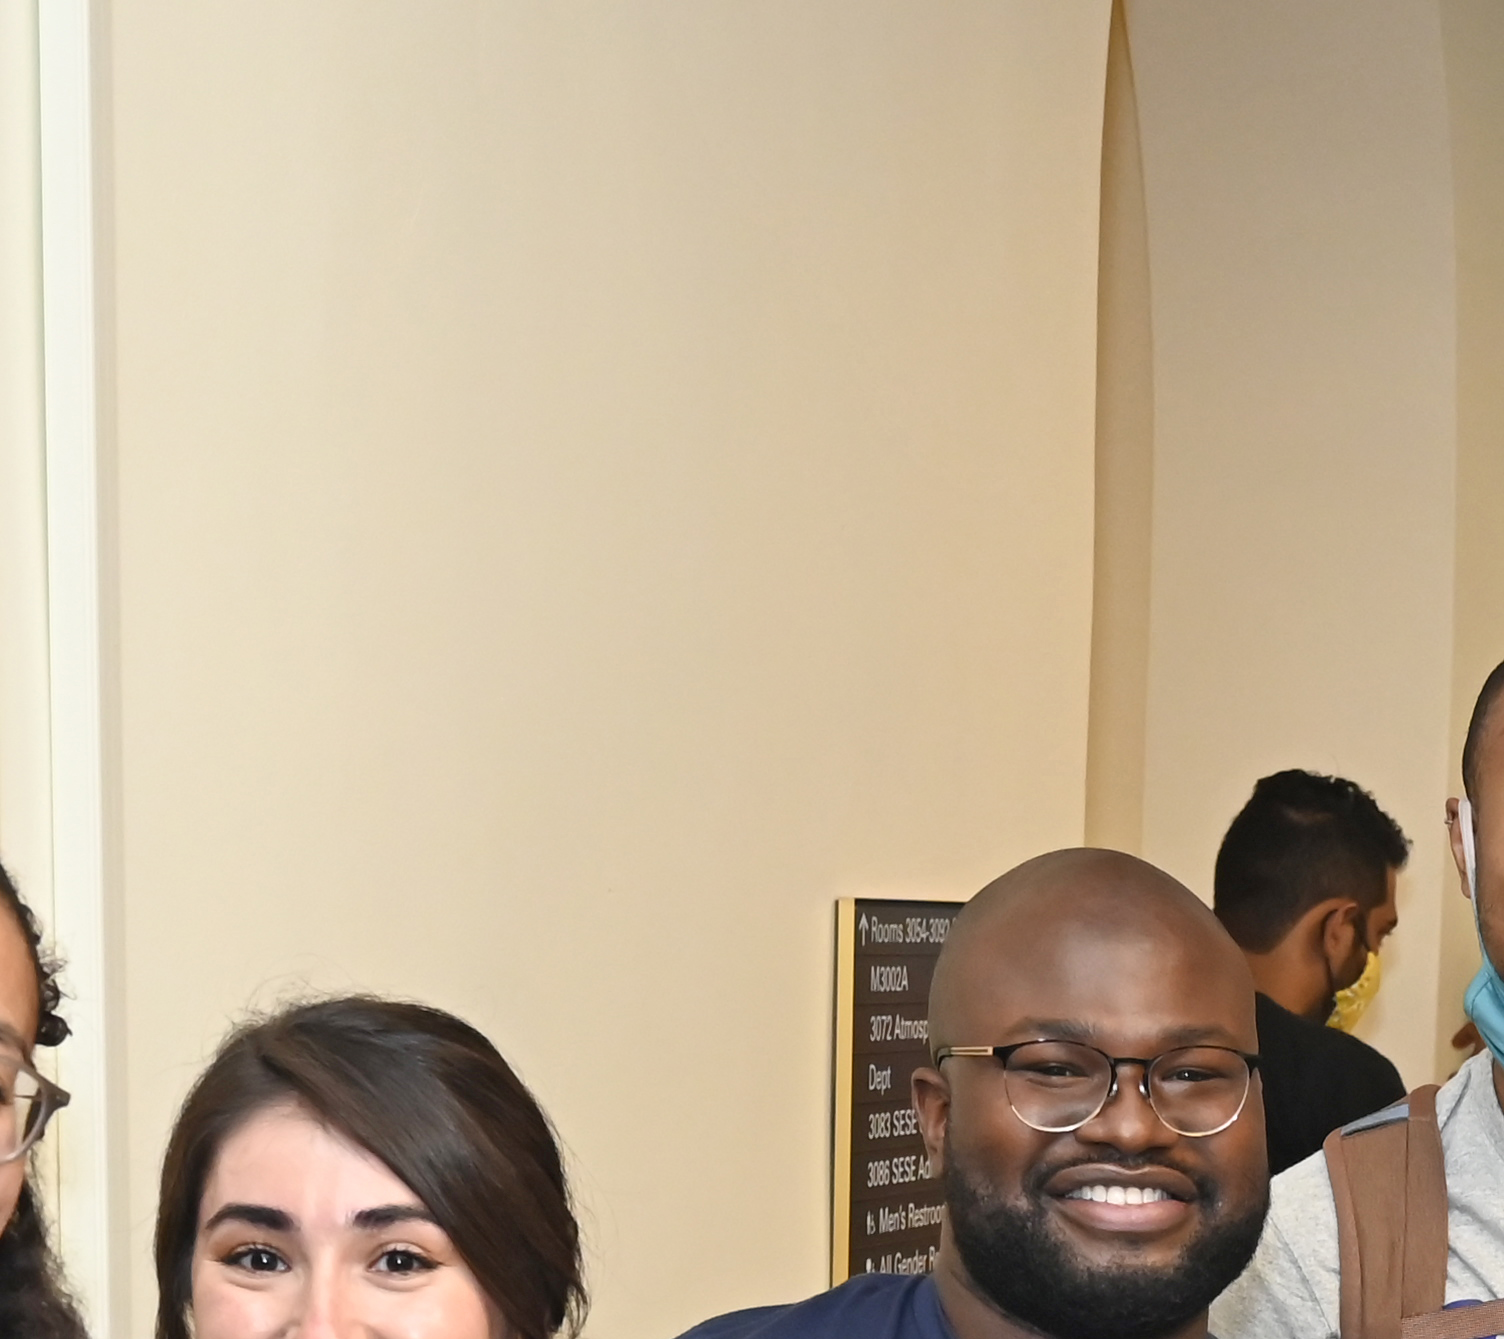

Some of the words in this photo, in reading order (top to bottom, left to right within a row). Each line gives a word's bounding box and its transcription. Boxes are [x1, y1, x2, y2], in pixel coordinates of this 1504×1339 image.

[871, 916, 903, 944] Rooms
[870, 965, 909, 993] M3002A
[870, 1014, 893, 1042] 3072
[868, 1063, 891, 1092] Dept
[868, 1113, 891, 1140] 3083
[893, 1109, 917, 1137] SESE
[867, 1160, 890, 1188] 3086
[892, 1155, 916, 1184] SESE
[879, 1204, 906, 1235] Men's
[894, 1249, 927, 1275] Gender
